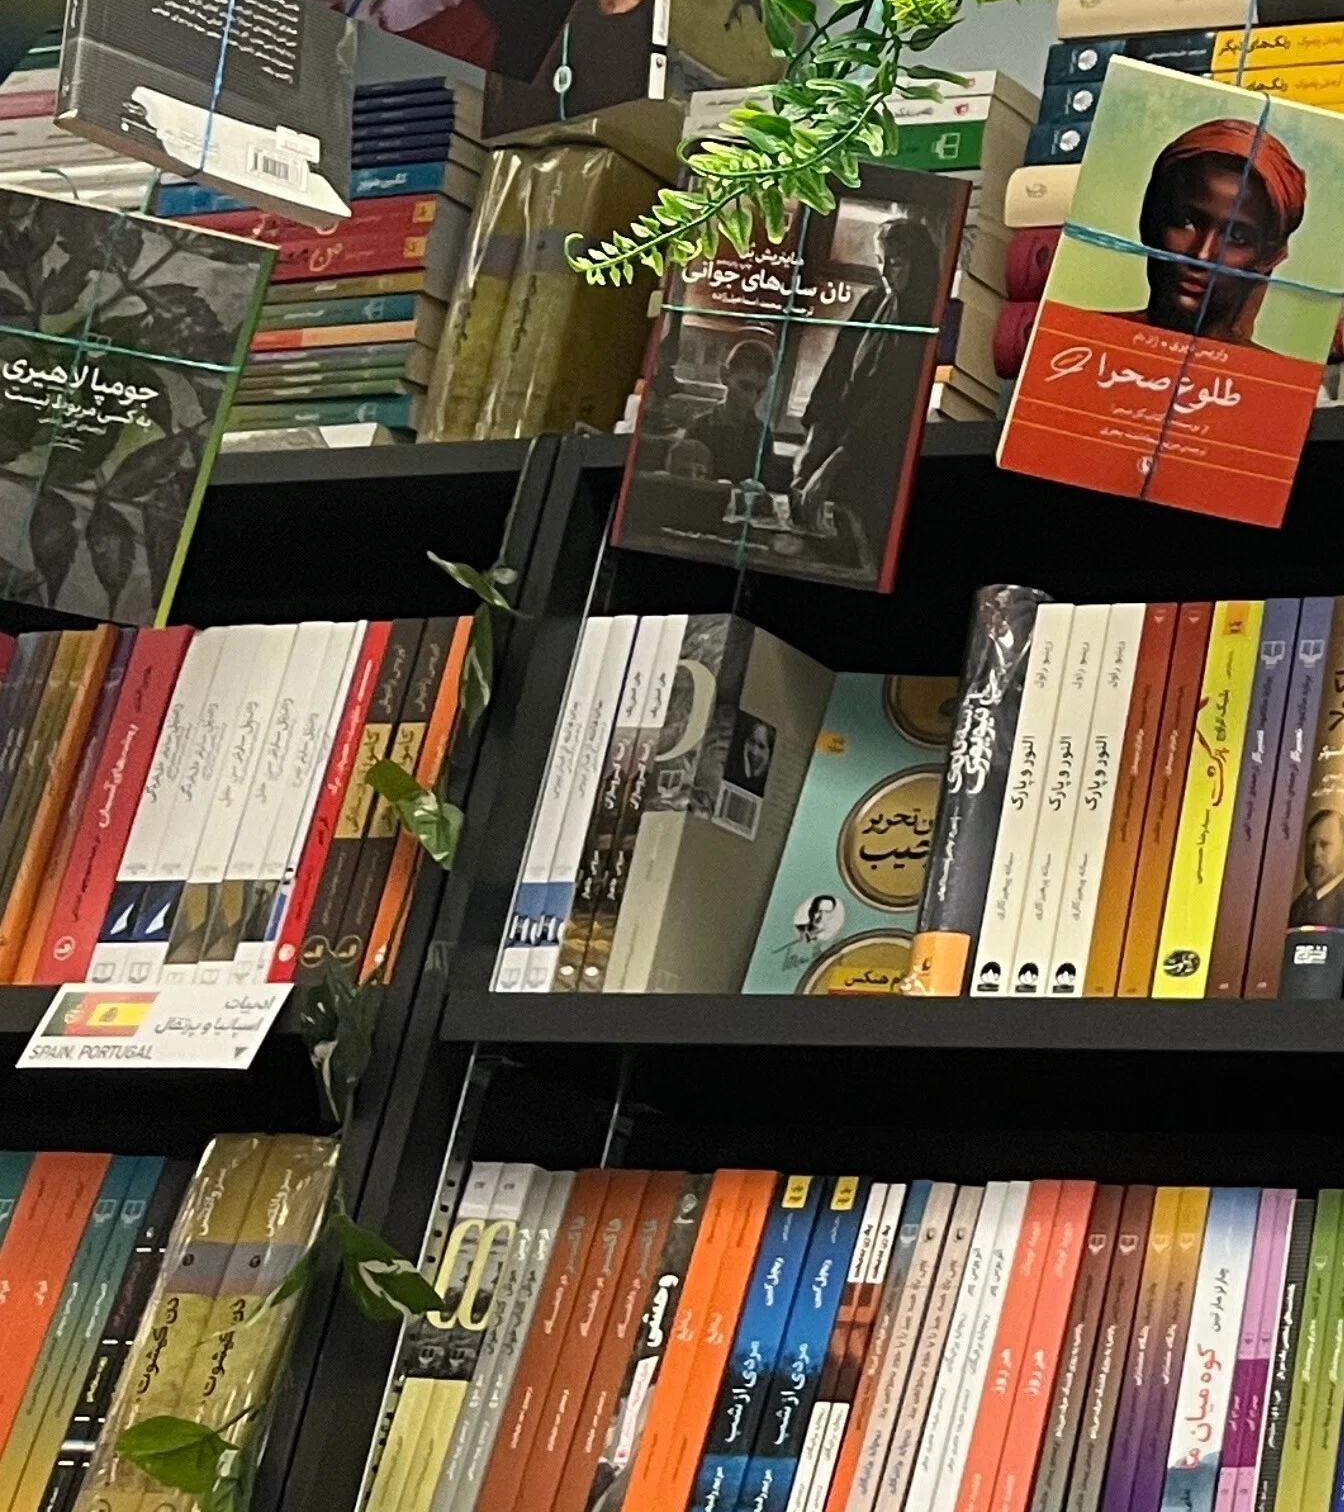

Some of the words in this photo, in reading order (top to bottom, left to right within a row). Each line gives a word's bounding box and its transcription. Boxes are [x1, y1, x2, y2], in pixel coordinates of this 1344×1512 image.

[680, 260, 740, 286] جوانی
[819, 280, 852, 304] نان
[2, 357, 89, 388] لاهیری
[1096, 352, 1171, 390] صحرا
[87, 367, 159, 409] جومپا
[1173, 376, 1241, 414] طلوع
[1020, 735, 1036, 766] النور
[1058, 735, 1073, 766] النور
[1095, 735, 1109, 766] النور
[1011, 779, 1033, 811] پارک
[1049, 779, 1071, 812] پارک
[1085, 779, 1108, 812] پارک
[223, 995, 276, 1014] ادبیات
[154, 1016, 202, 1039] پرتغال
[212, 1016, 263, 1038] اسپانیا
[77, 1043, 154, 1061] PORTUGAL
[1213, 1267, 1228, 1295] چارلز
[643, 1273, 679, 1348] وحشی
[1208, 1295, 1223, 1333] مارتین
[135, 1325, 169, 1403] کیشوت
[738, 1340, 761, 1388] مردی
[787, 1342, 810, 1390] مردی
[1196, 1343, 1222, 1384] کوه
[992, 1370, 1008, 1394] روز
[1024, 1371, 1042, 1397] روز
[723, 1406, 747, 1443] شب
[771, 1406, 793, 1445] شب
[1184, 1388, 1215, 1443] میان
[1175, 1447, 1200, 1472] ما
